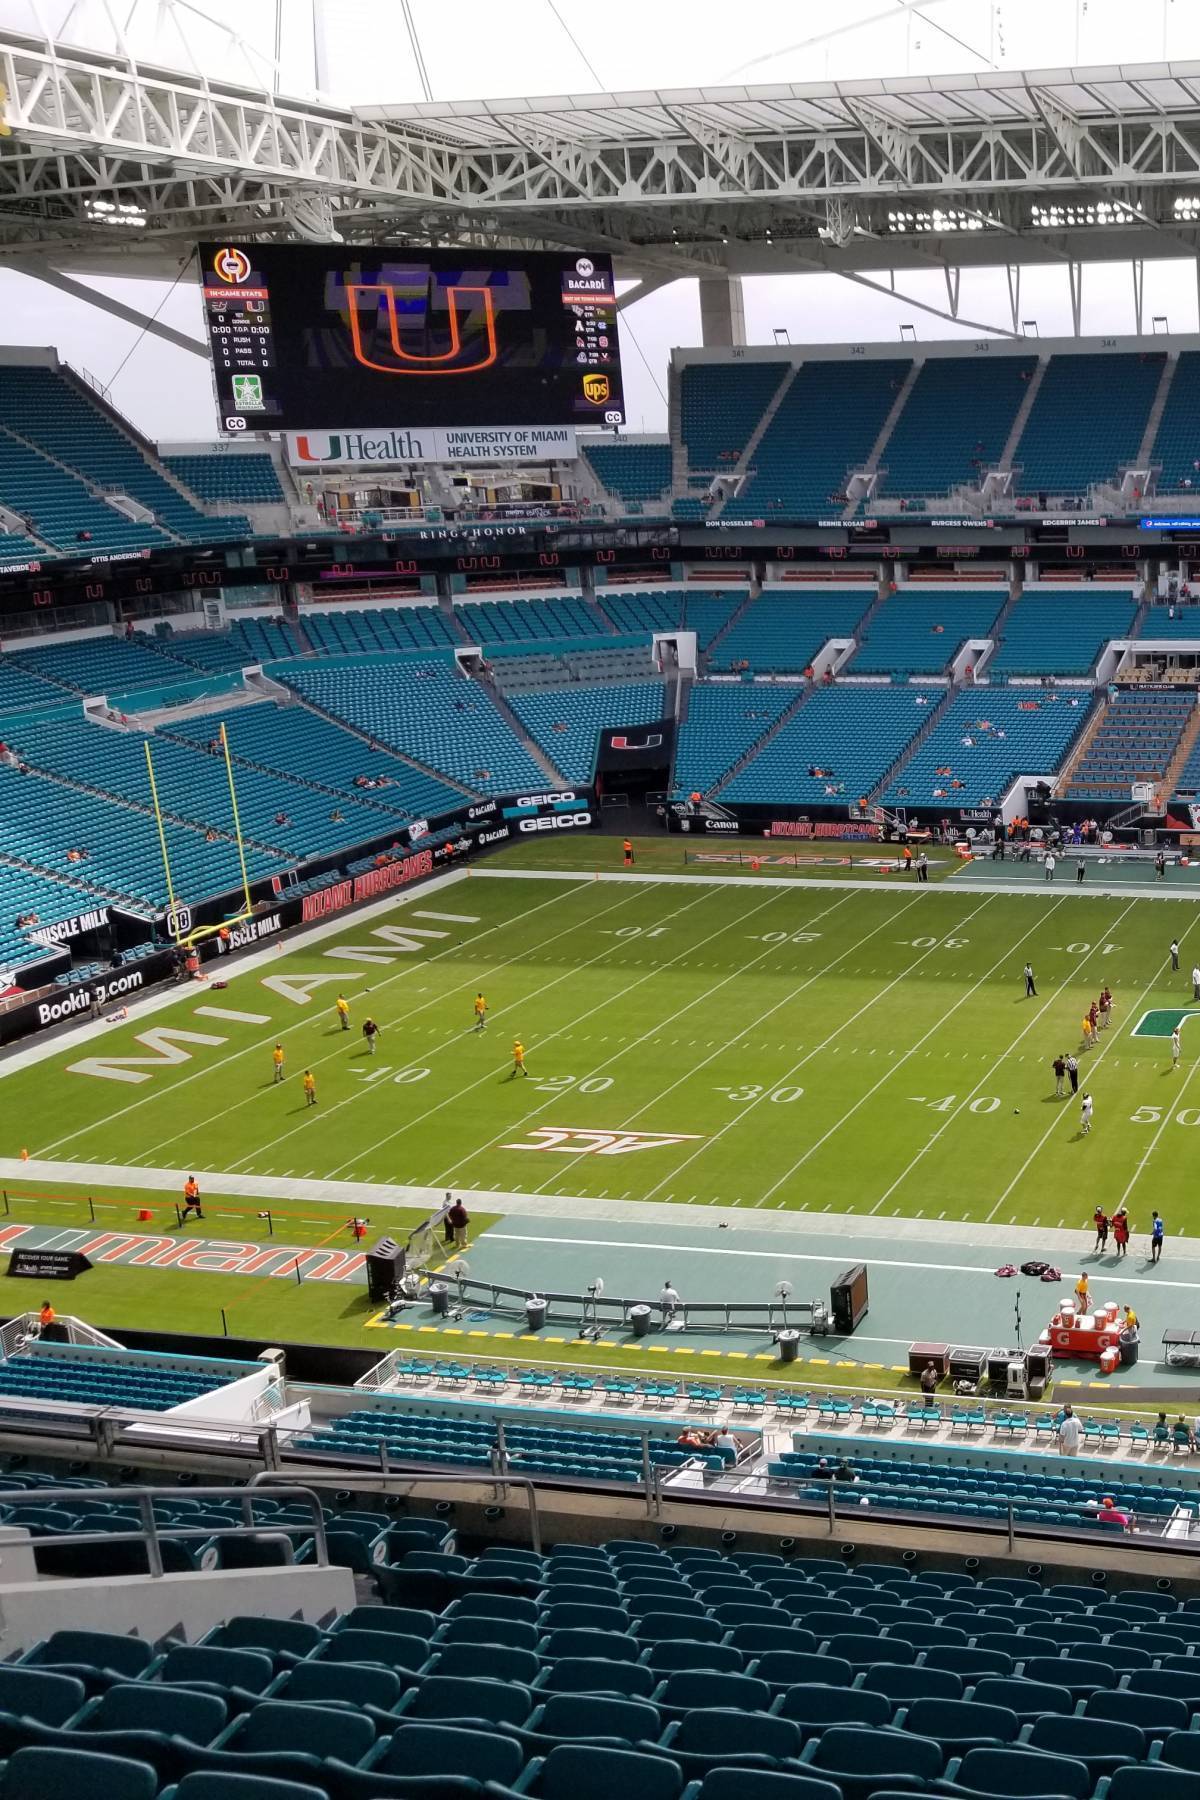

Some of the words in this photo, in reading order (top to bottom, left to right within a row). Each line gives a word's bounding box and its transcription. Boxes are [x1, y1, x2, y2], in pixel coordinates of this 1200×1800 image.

[586, 383, 607, 400] ups
[228, 419, 245, 428] CC
[606, 413, 620, 422] CC
[446, 431, 512, 445] UNIVERSITY
[514, 431, 529, 442] OF
[531, 430, 568, 442] MIAMI
[212, 443, 229, 452] 337
[448, 445, 491, 457] HEALTH
[493, 445, 537, 456] SYSTEM
[419, 529, 458, 540] RING
[472, 526, 527, 537] HONOR
[110, 551, 142, 561] ANDERSON
[517, 791, 575, 807] GEICO
[519, 812, 592, 832] GEICO
[705, 820, 739, 829] Canon
[771, 821, 813, 836] MIAMI
[302, 881, 352, 922] MIAMI
[354, 850, 433, 902] HURRICANES
[32, 917, 79, 944] MUSCLE
[79, 908, 110, 932] MILK
[258, 914, 282, 937] MILK
[367, 1066, 432, 1084] 10
[533, 1074, 614, 1093] 20
[728, 1085, 803, 1103] 30
[926, 1096, 1001, 1113] 40
[1057, 1332, 1070, 1345] G
[1097, 1335, 1110, 1348] G
